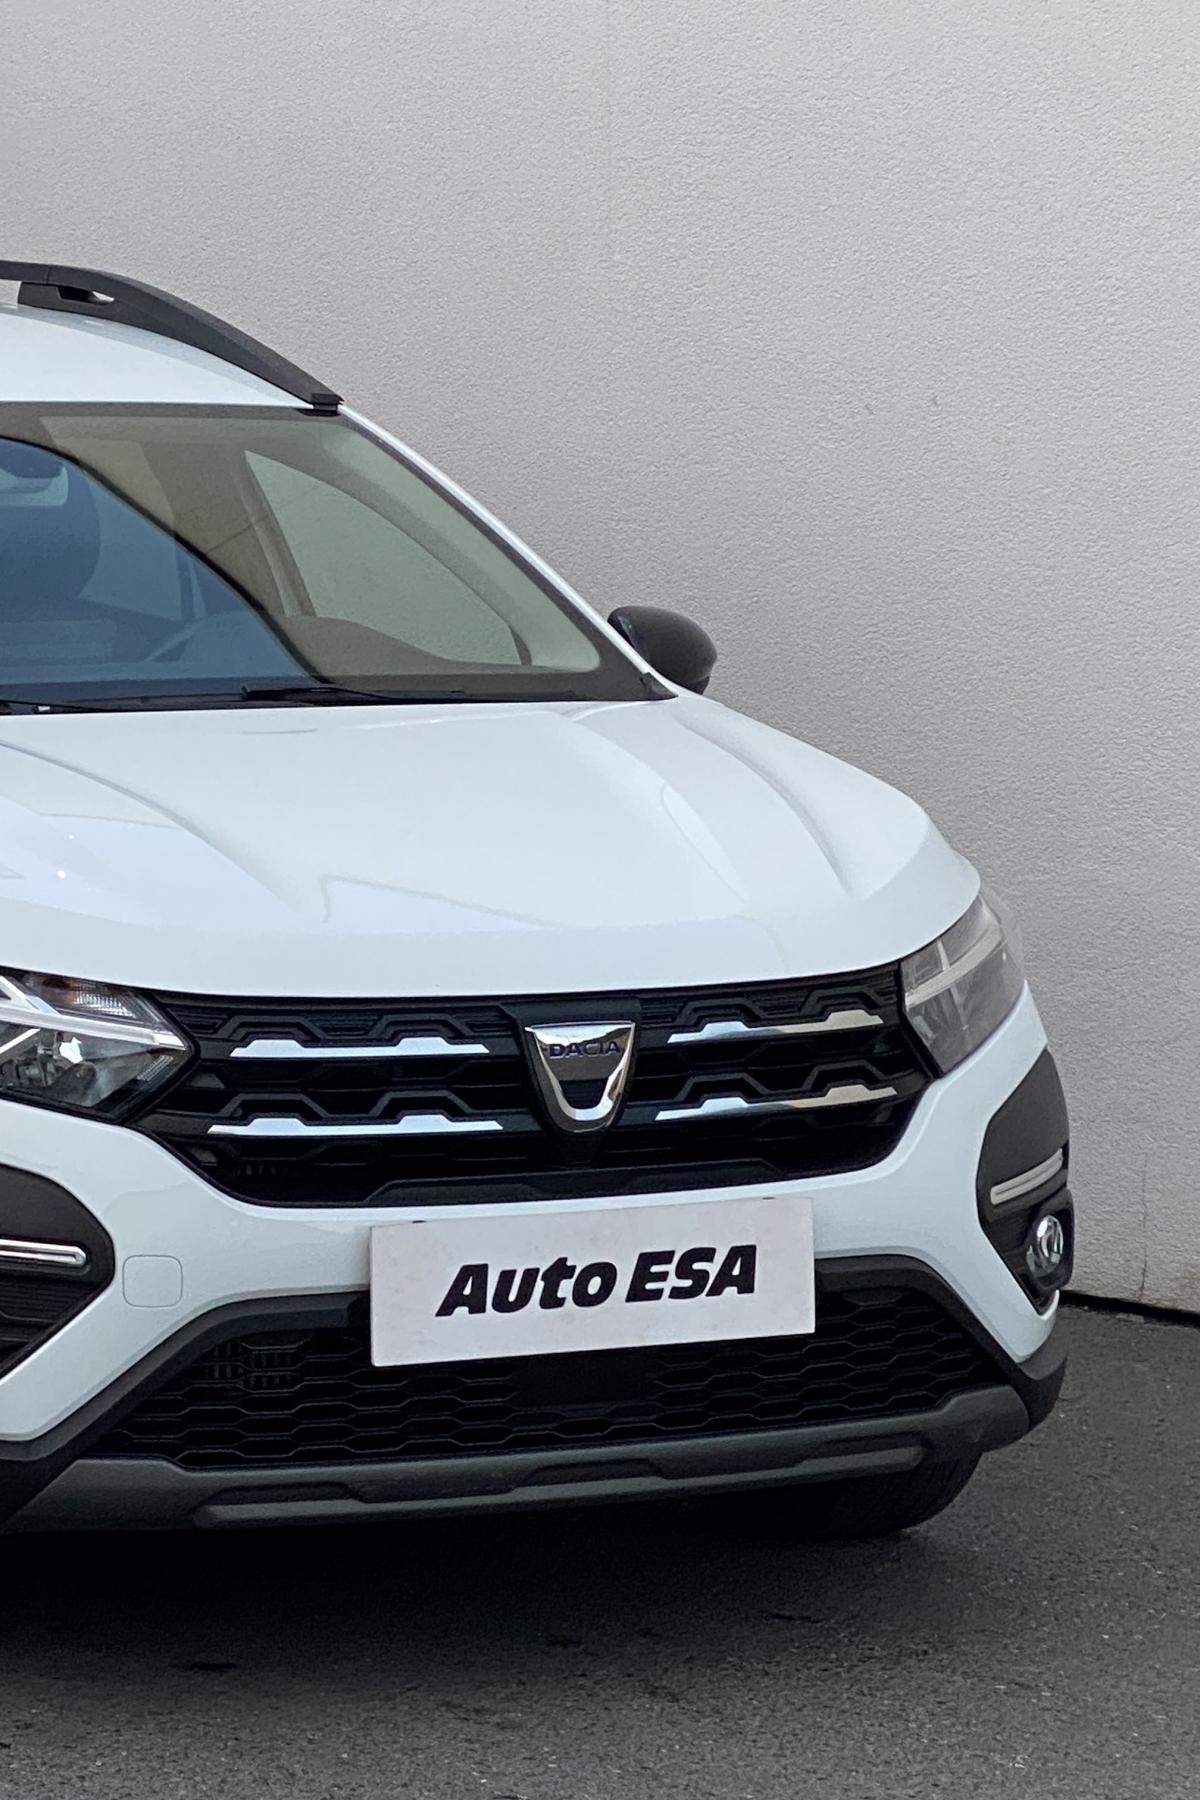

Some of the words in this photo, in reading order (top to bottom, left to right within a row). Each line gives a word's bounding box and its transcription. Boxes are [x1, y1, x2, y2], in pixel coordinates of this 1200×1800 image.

[548, 1041, 621, 1058] DACIA
[435, 1256, 618, 1317] Auto
[624, 1244, 757, 1304] ESA
